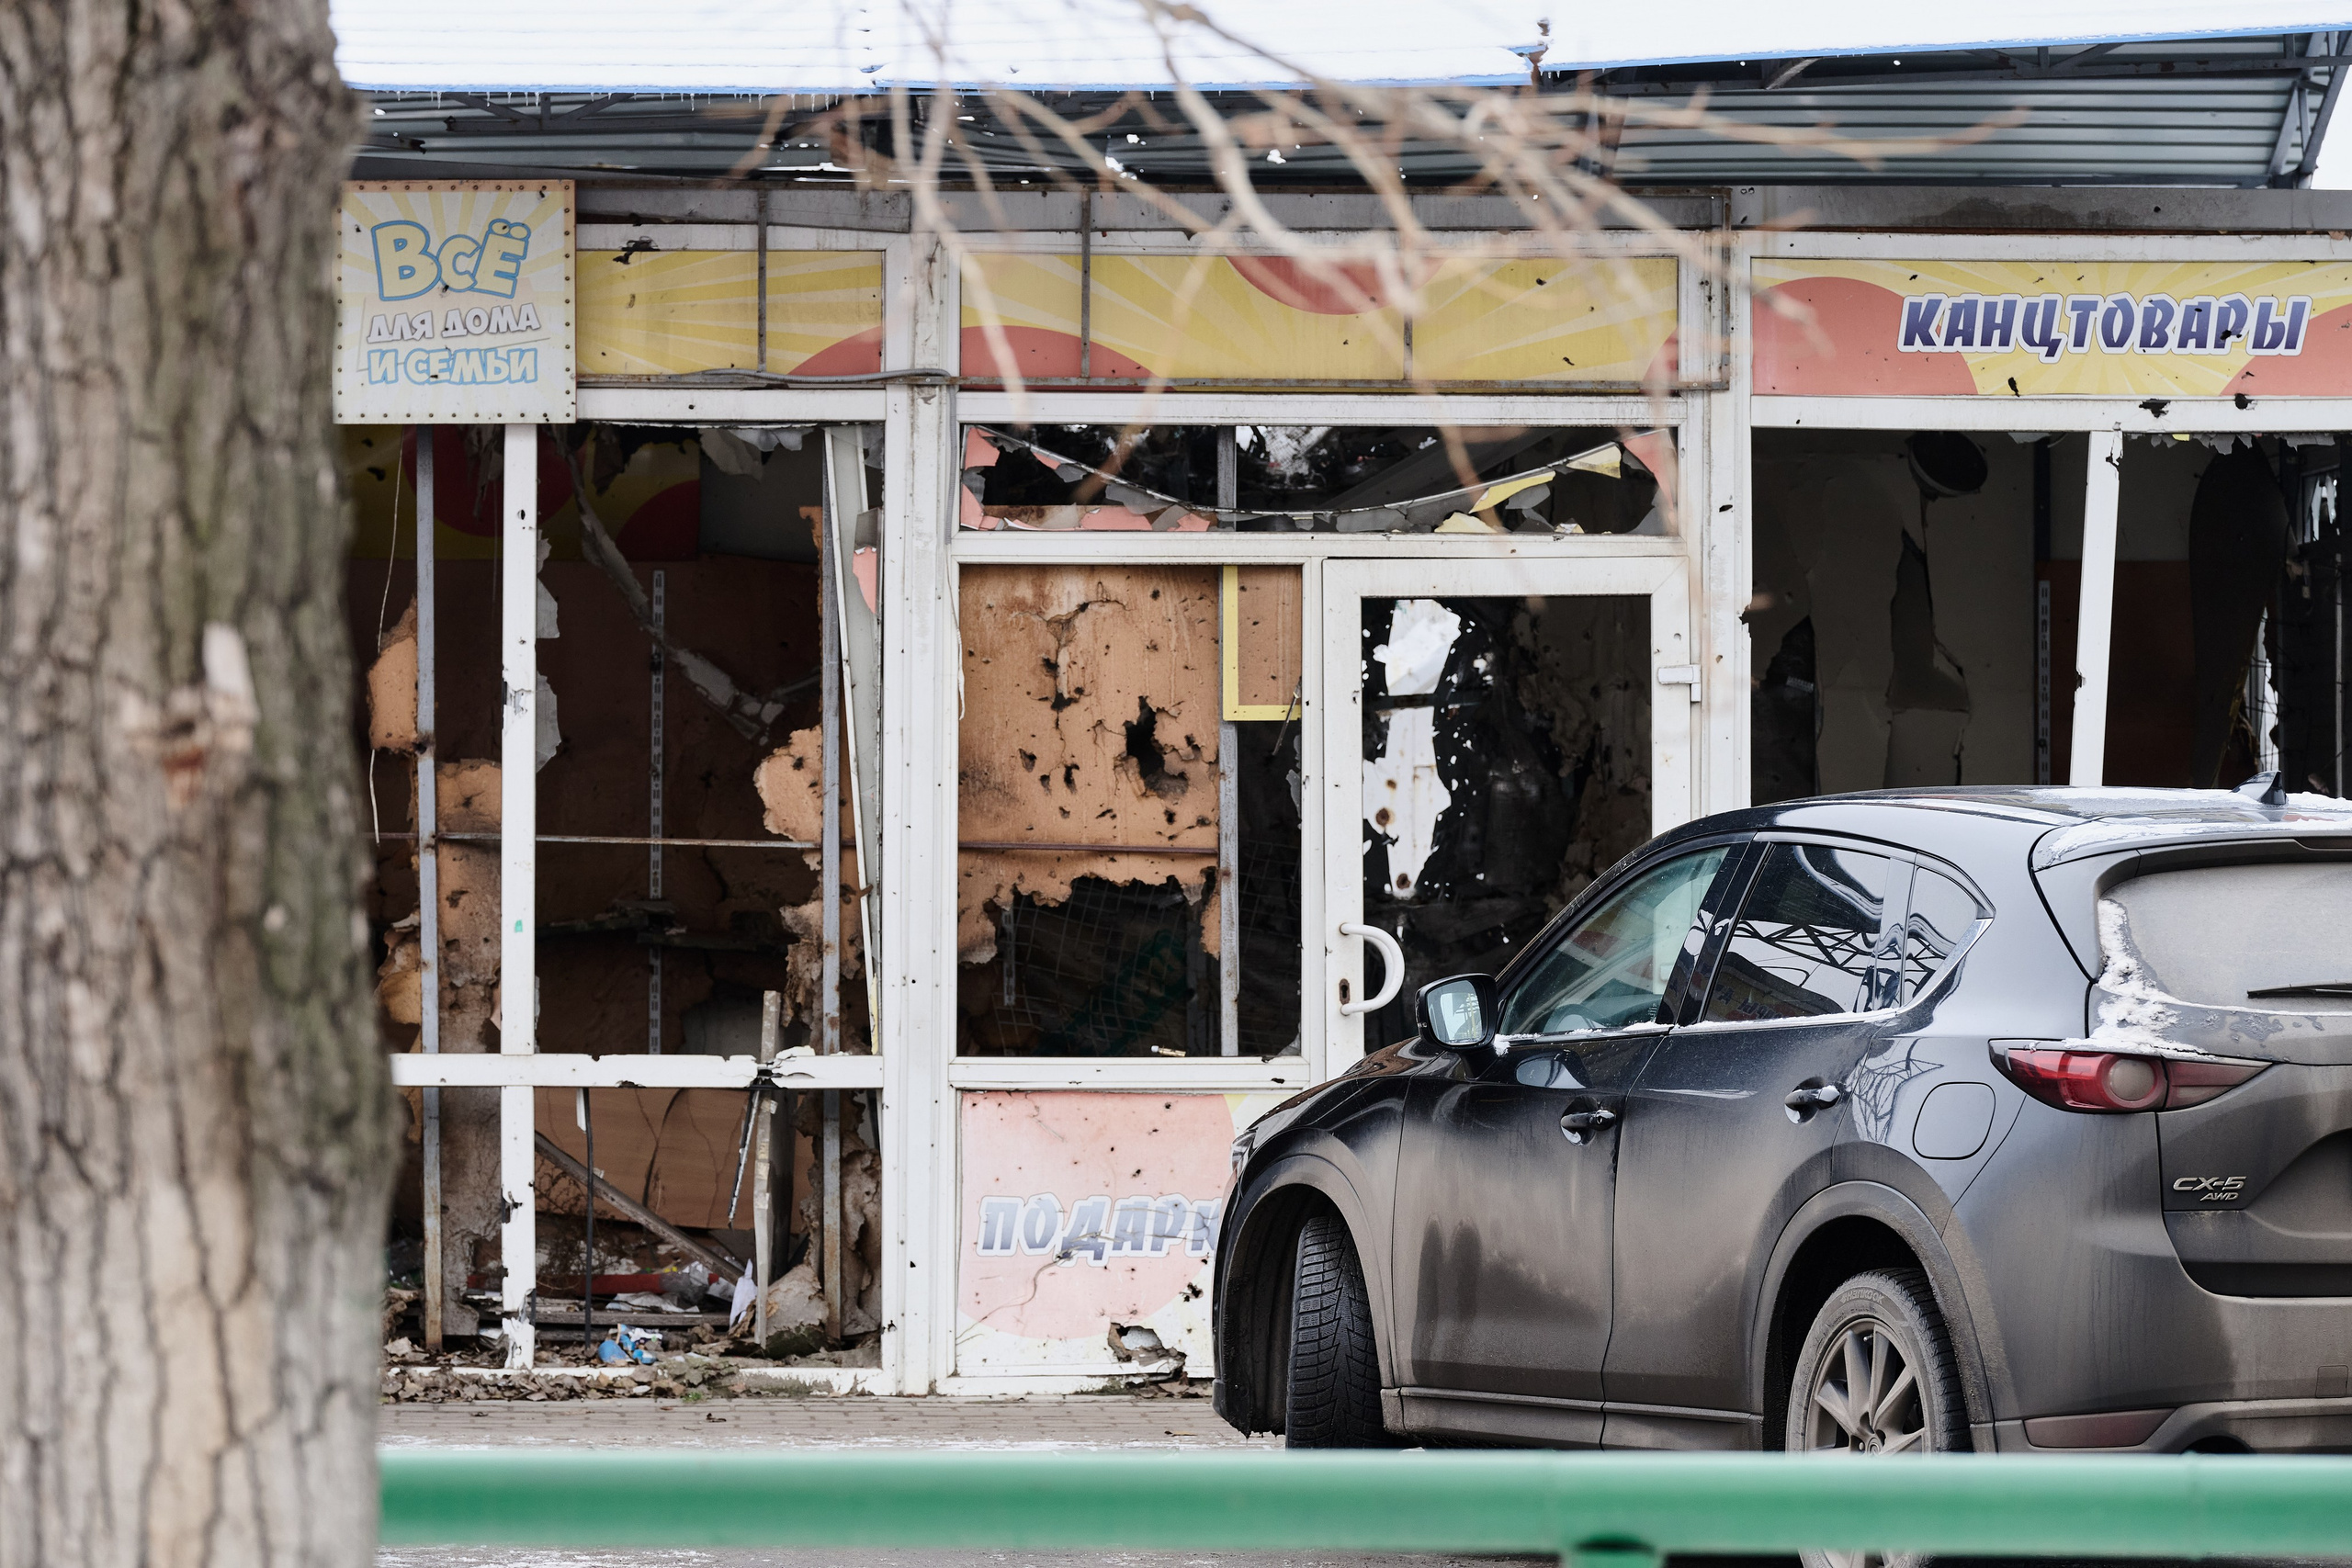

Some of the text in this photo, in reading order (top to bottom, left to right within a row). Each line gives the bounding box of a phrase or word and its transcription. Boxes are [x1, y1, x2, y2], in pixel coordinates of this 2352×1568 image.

[371, 219, 531, 301] ВСЁ
[367, 303, 541, 344] ДЛЯ ДОМА
[1898, 293, 2312, 363] КАНЦТОВАРЫ
[368, 348, 537, 385] И СЕМЬИ
[2173, 1176, 2247, 1191] CX-5
[2199, 1192, 2239, 1201] AWD
